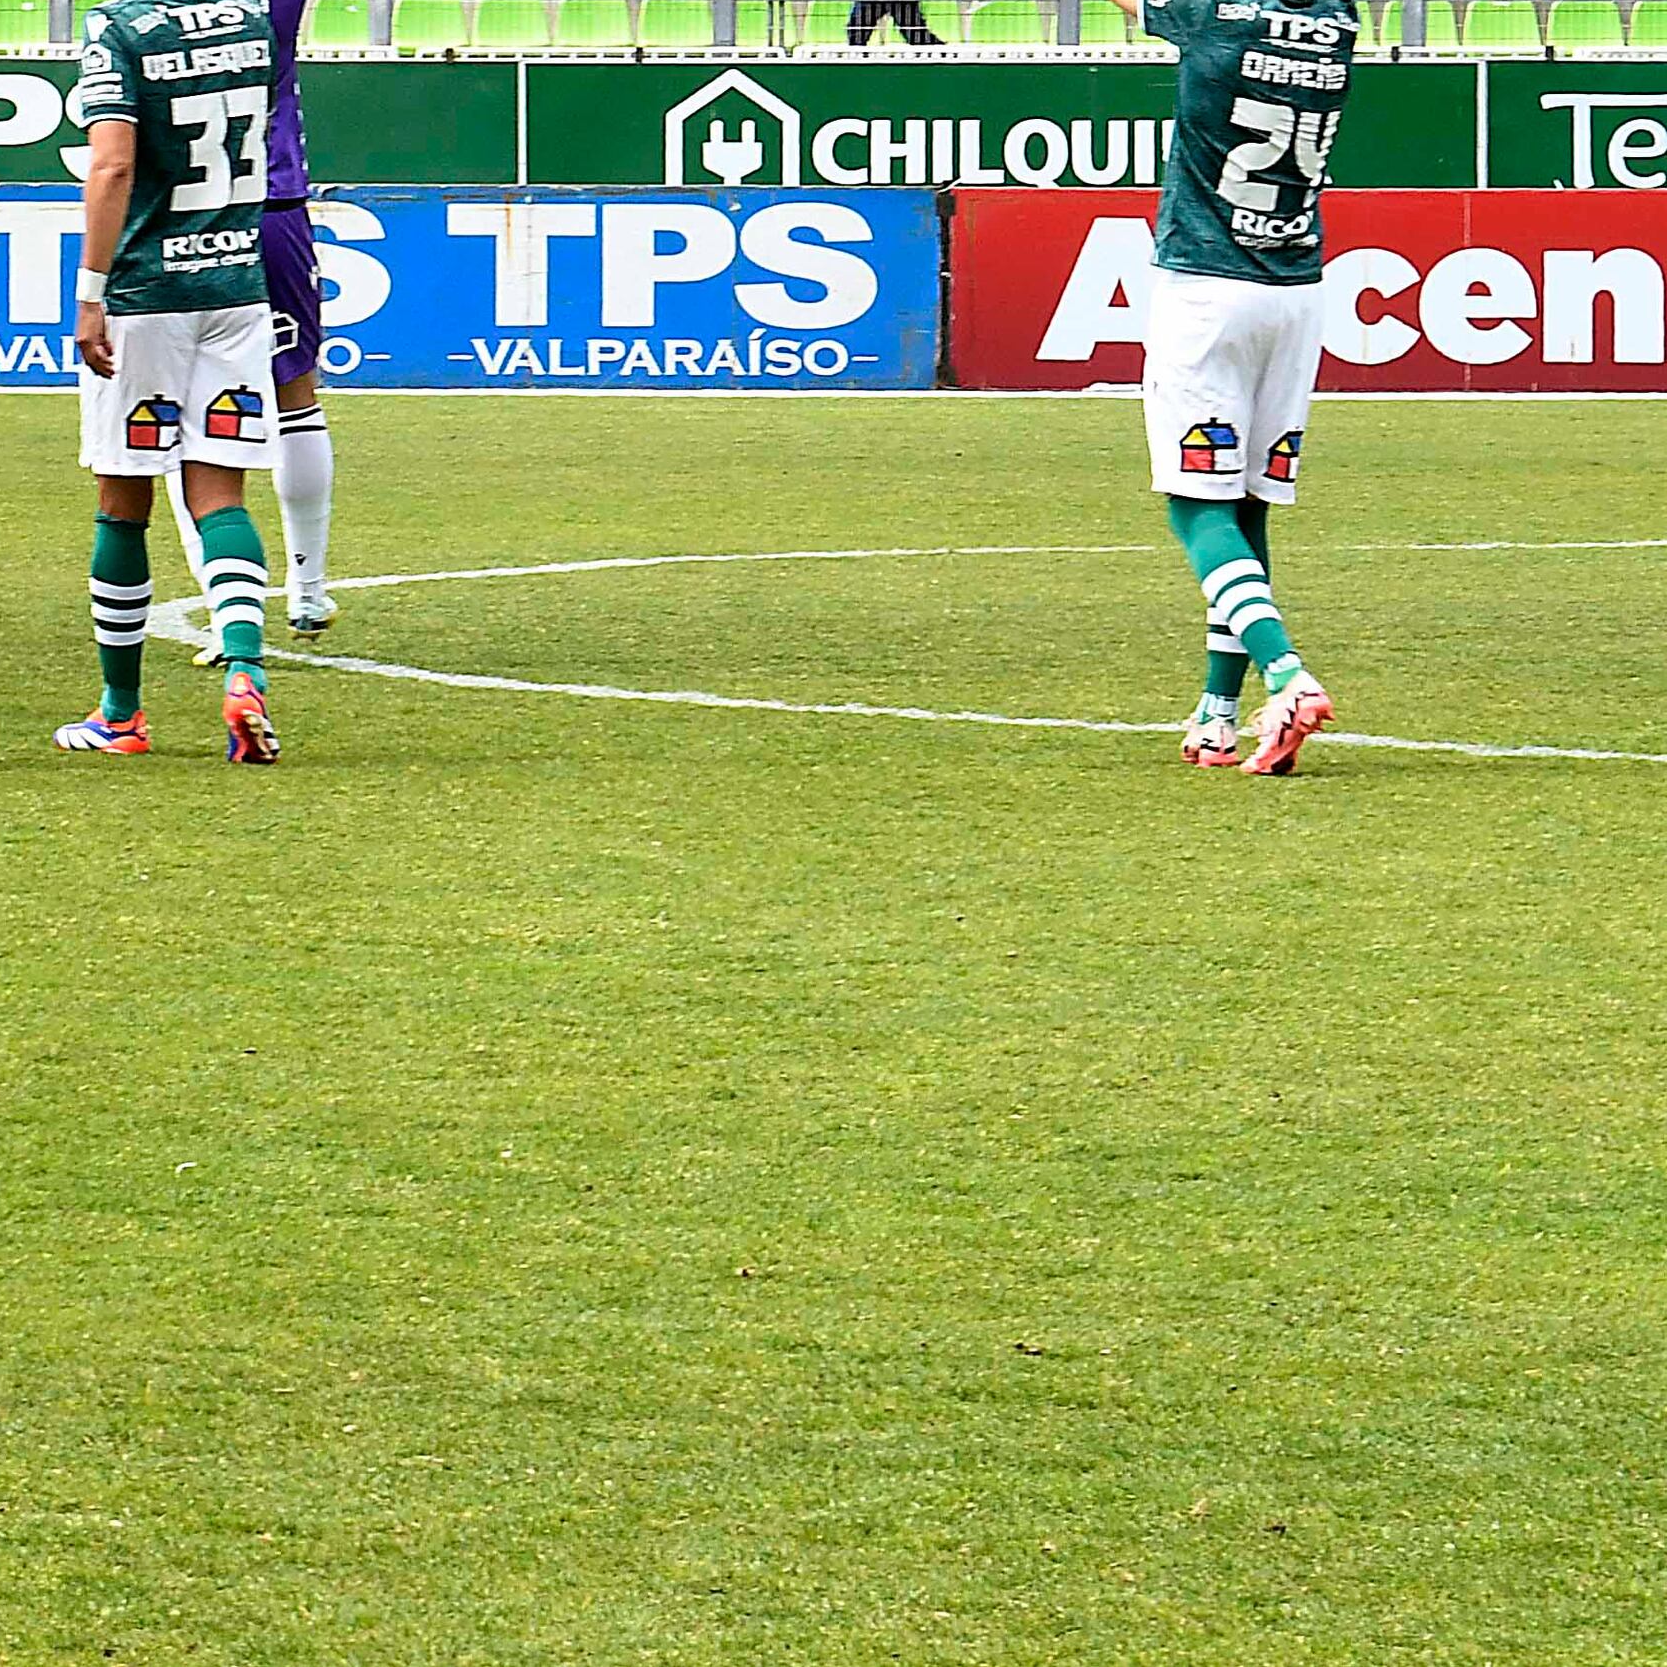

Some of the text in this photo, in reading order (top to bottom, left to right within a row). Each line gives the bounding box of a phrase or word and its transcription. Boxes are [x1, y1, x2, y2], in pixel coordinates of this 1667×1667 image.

[167, 0, 245, 33] TPS
[1260, 10, 1341, 45] TPS
[170, 86, 269, 212] 33
[812, 119, 1173, 188] CHILQUI
[163, 228, 260, 259] RICOH
[447, 202, 879, 330] TPS
[1035, 217, 1666, 365] Acen
